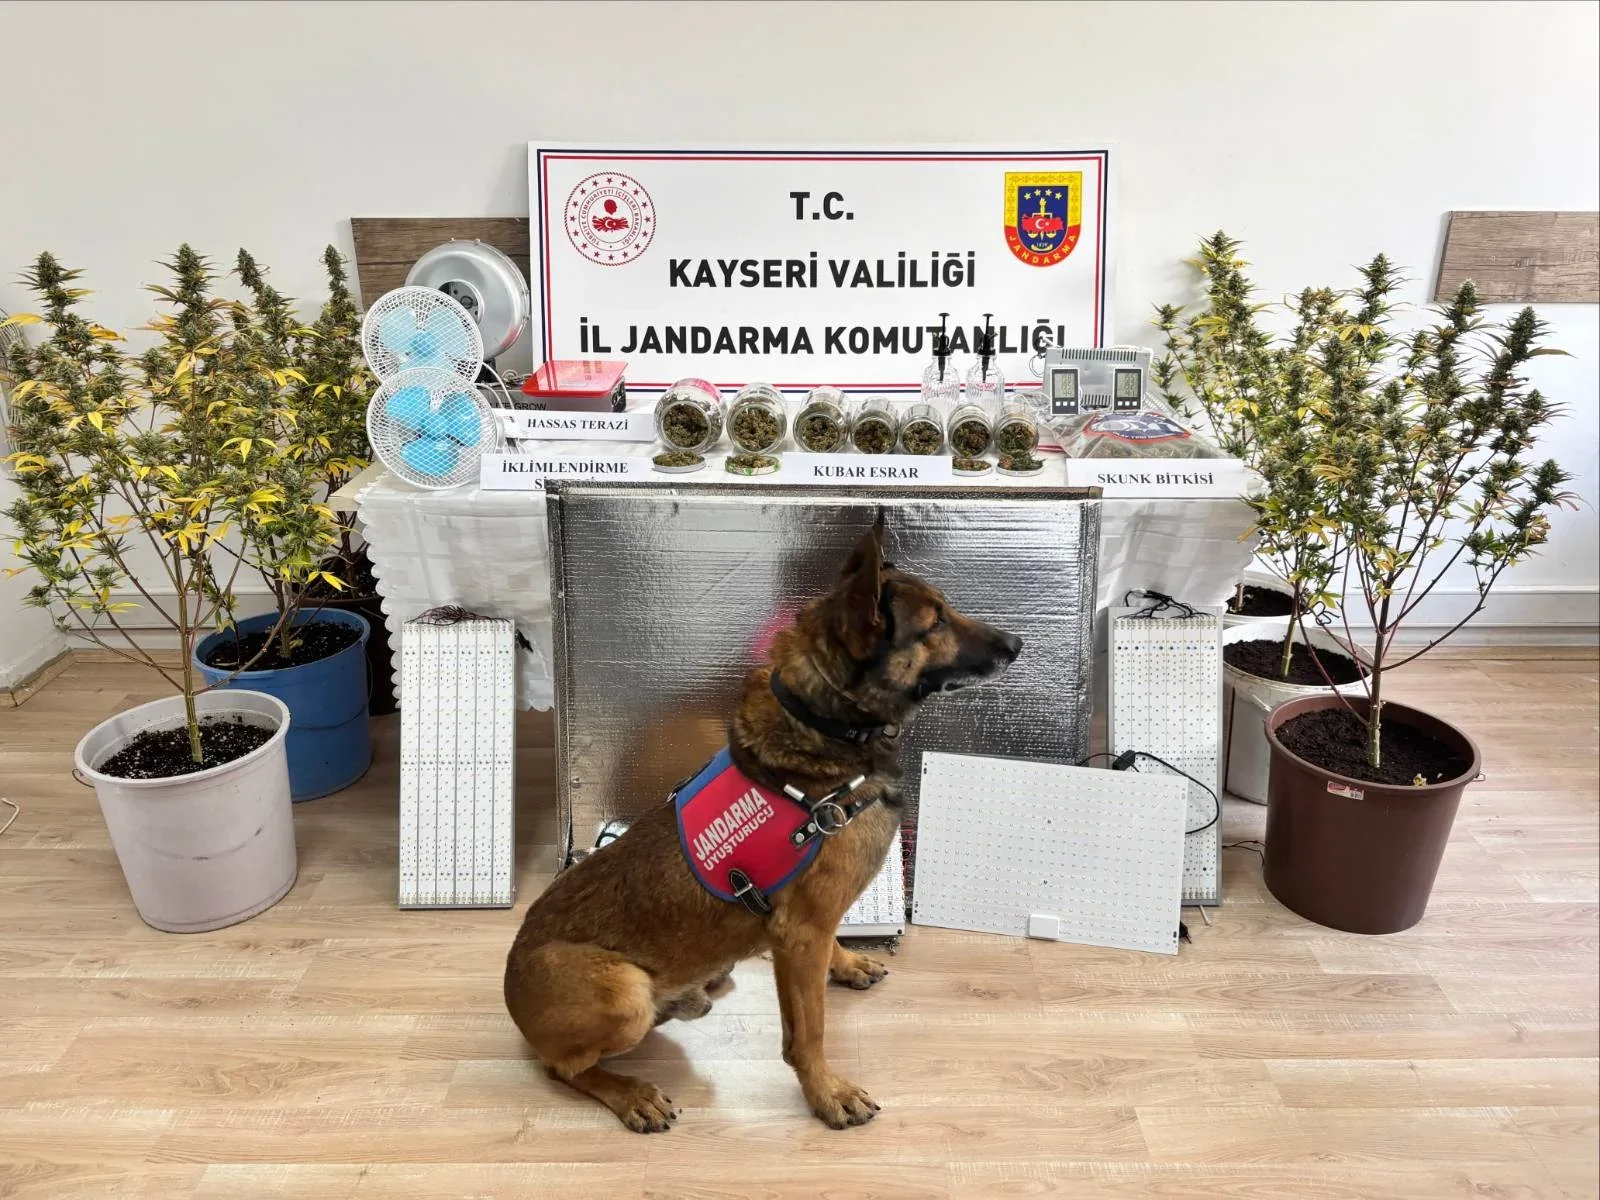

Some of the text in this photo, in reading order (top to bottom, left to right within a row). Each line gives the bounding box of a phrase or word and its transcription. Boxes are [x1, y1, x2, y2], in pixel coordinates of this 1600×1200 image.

[582, 189, 614, 219] CUMHURİYETİ
[790, 191, 854, 221] T.C.
[1009, 235, 1076, 264] JANDARMA
[669, 250, 976, 288] KAYSERİ VALİLİĞİ
[579, 316, 612, 353] İL
[620, 325, 814, 355] JANDARMA
[527, 418, 629, 431] HASSAS TERAZİ
[502, 459, 629, 474] İKLİMLENDİRME
[813, 465, 920, 479] KUBAR ESRAR
[1097, 471, 1214, 485] SKUNK BİTKİSİ
[693, 787, 768, 861] JANDARMA
[703, 804, 774, 871] UYUŞTURUCU
